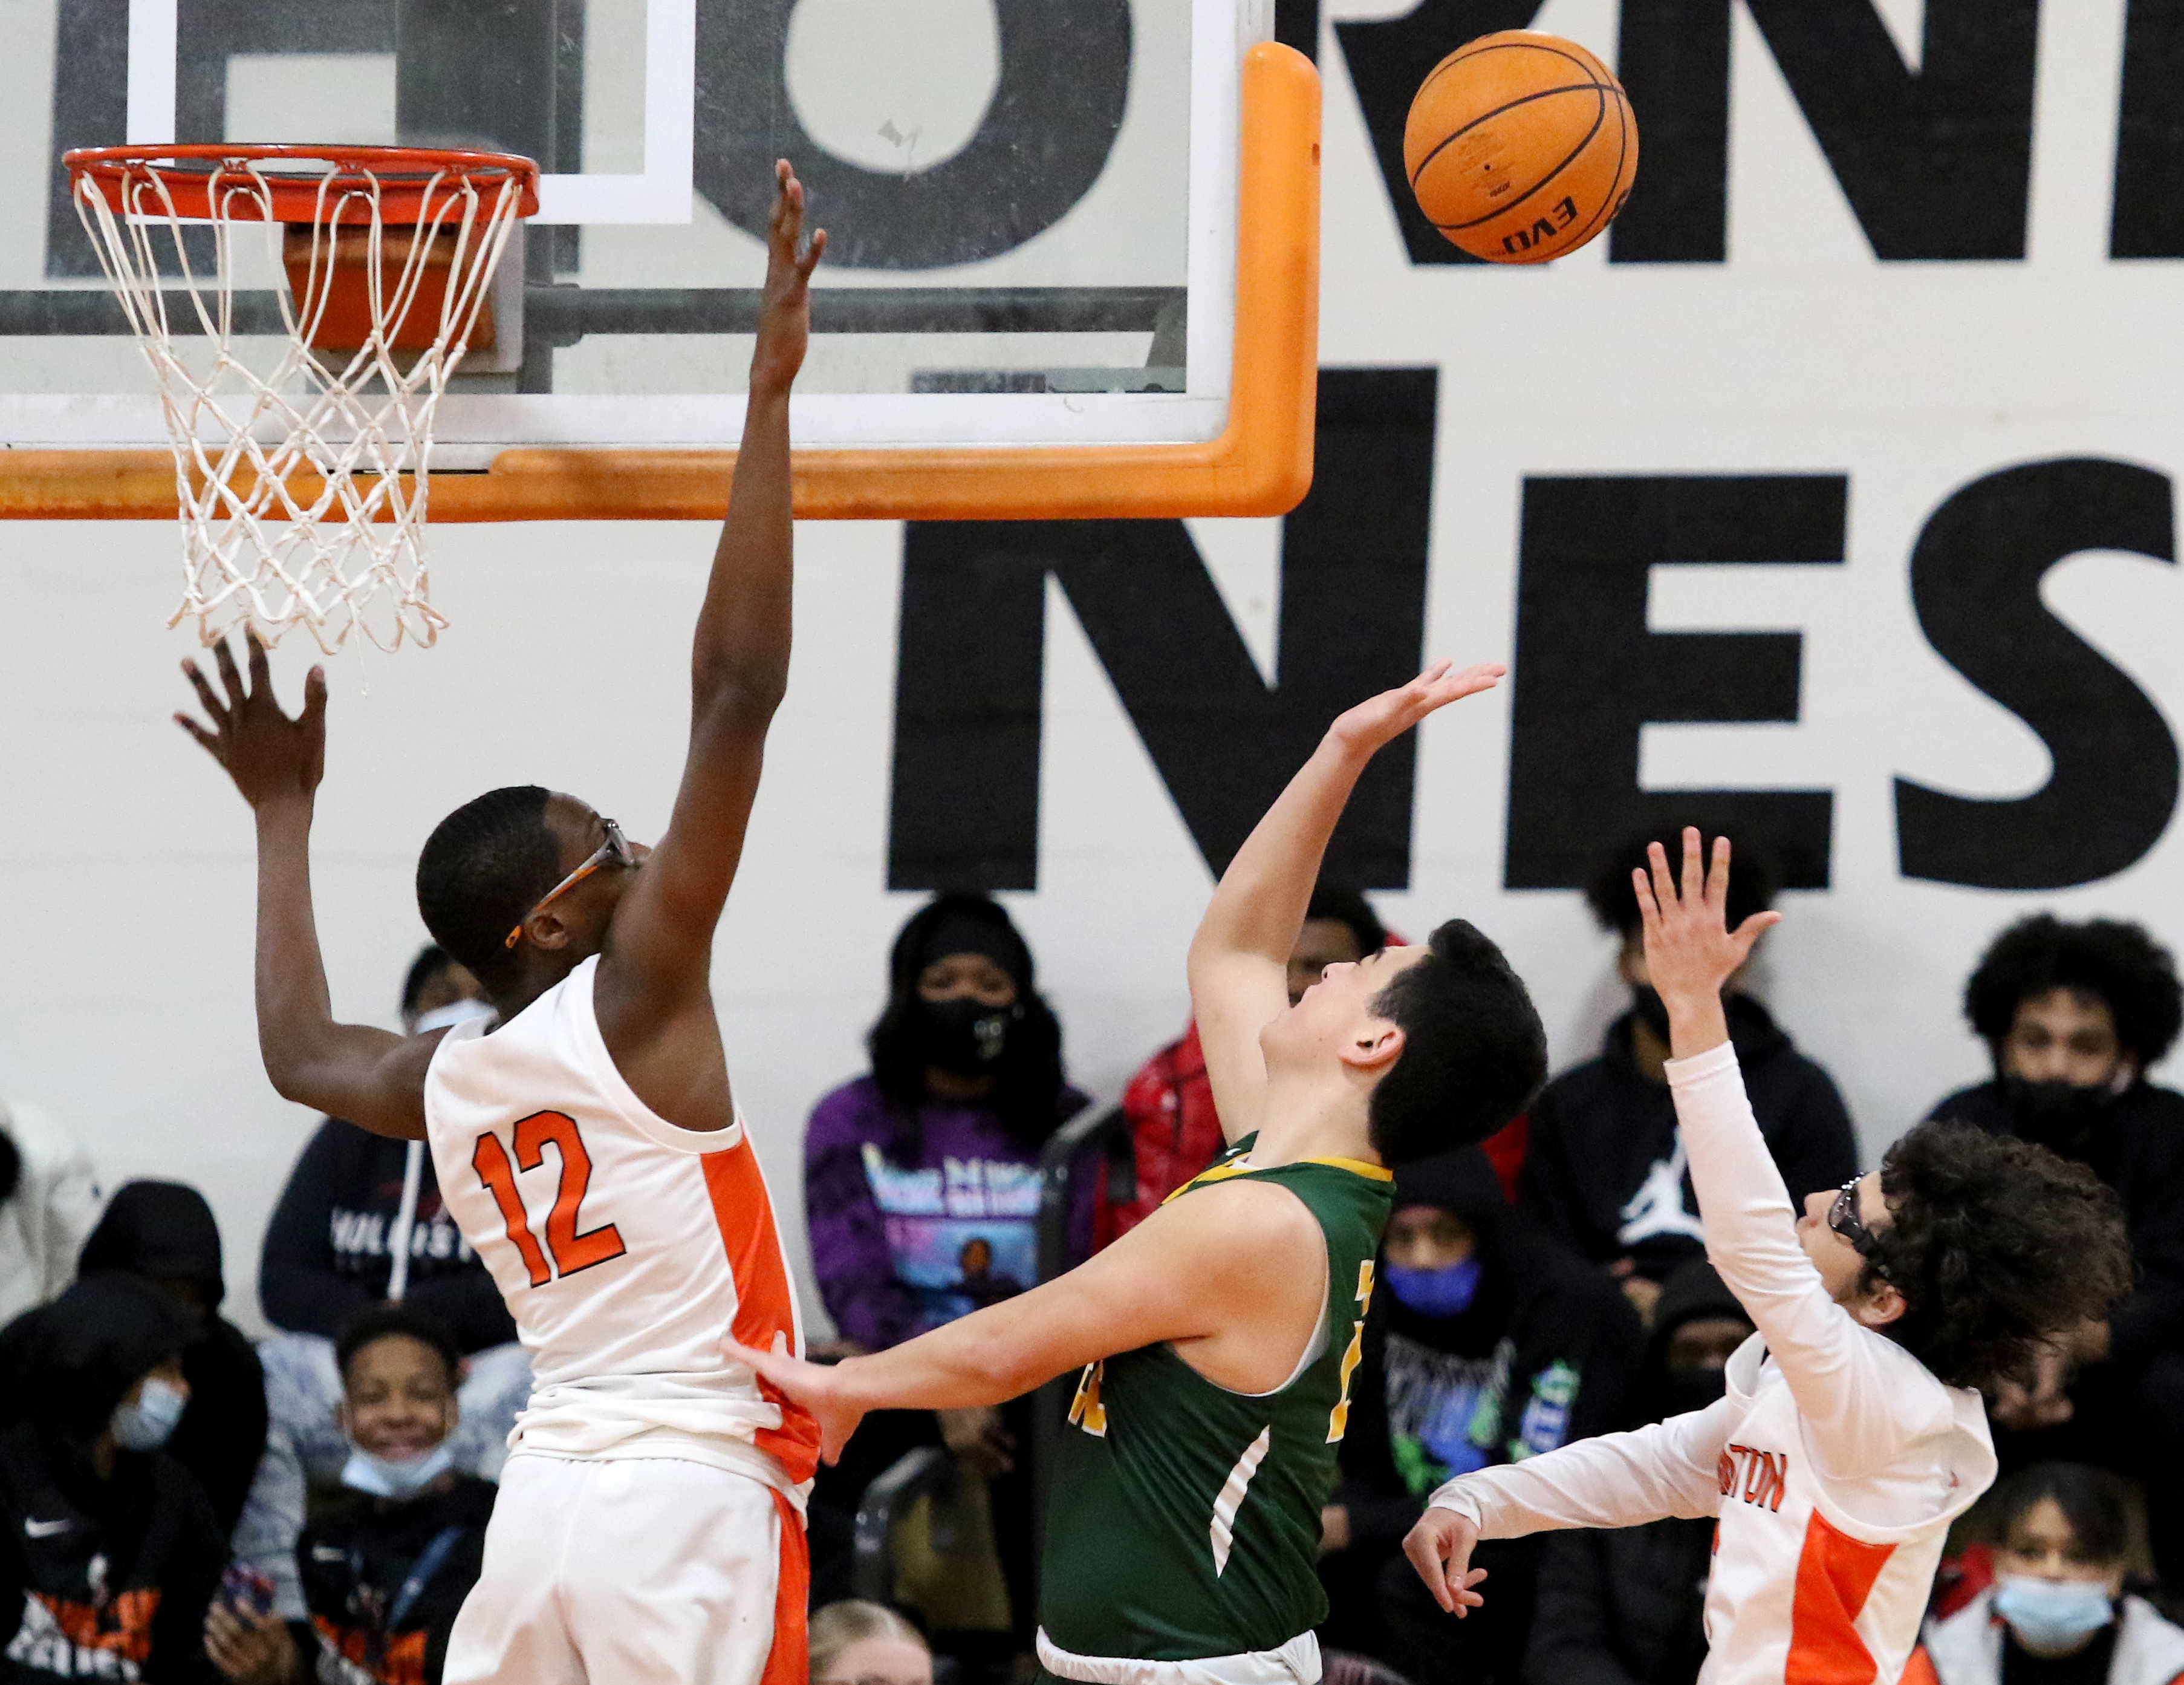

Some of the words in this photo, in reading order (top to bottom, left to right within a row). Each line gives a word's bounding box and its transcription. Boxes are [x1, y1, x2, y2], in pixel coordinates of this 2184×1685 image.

[1502, 195, 1578, 254] EVO
[885, 367, 2180, 891] NES
[473, 1110, 626, 1287] 12
